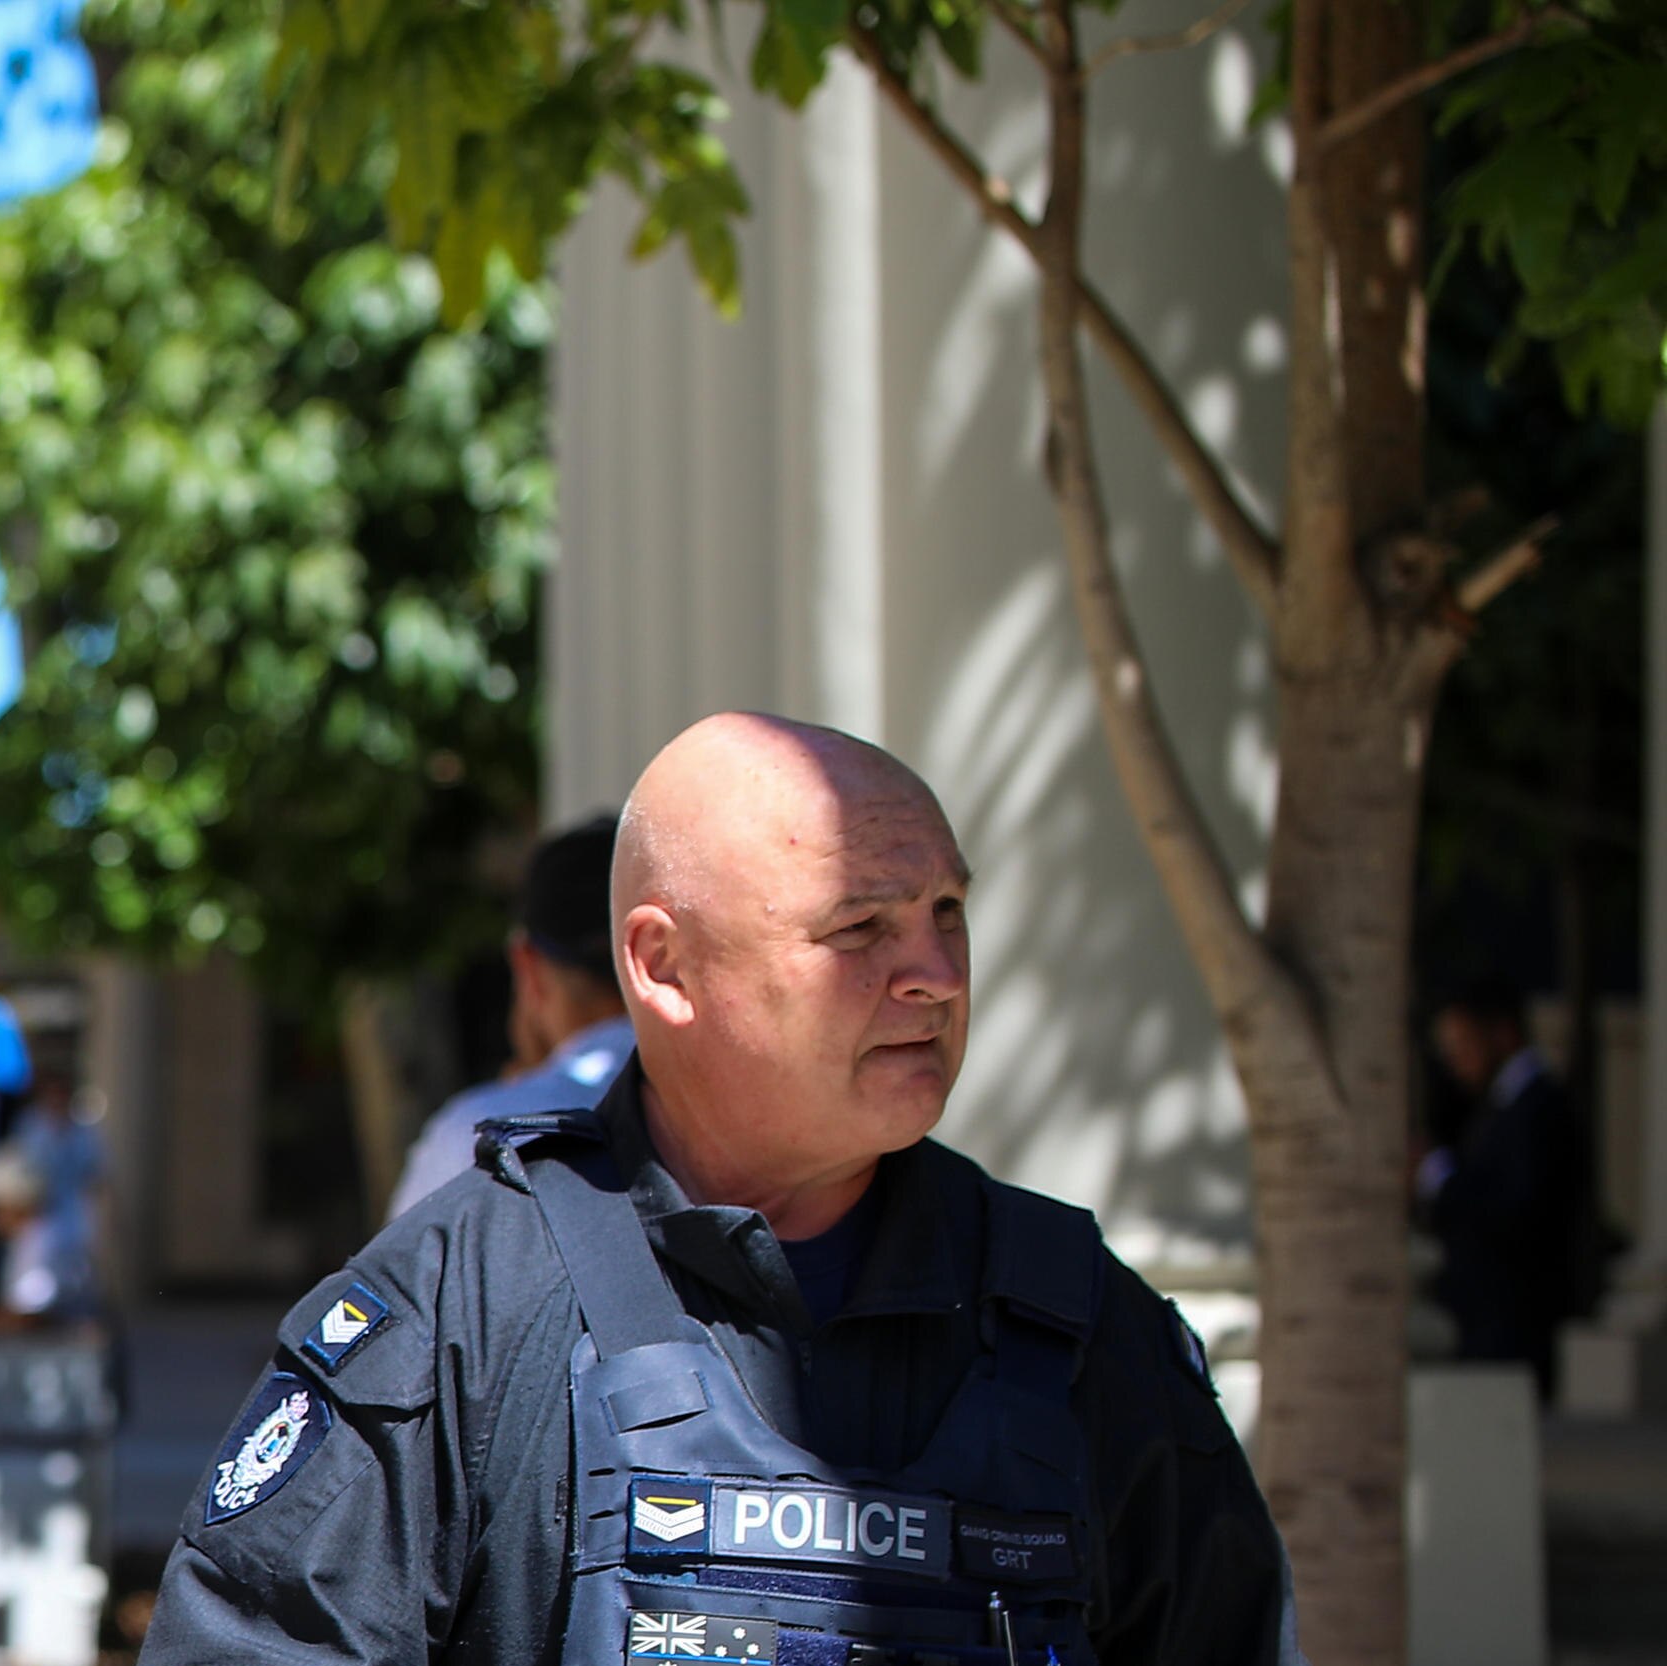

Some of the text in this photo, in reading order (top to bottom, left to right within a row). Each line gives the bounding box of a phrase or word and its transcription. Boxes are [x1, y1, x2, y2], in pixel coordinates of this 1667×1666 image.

[215, 1461, 259, 1509] POLICE
[733, 1494, 927, 1561] POLICE
[1023, 1534, 1066, 1546] SQUAD
[992, 1547, 1032, 1570] GRT
